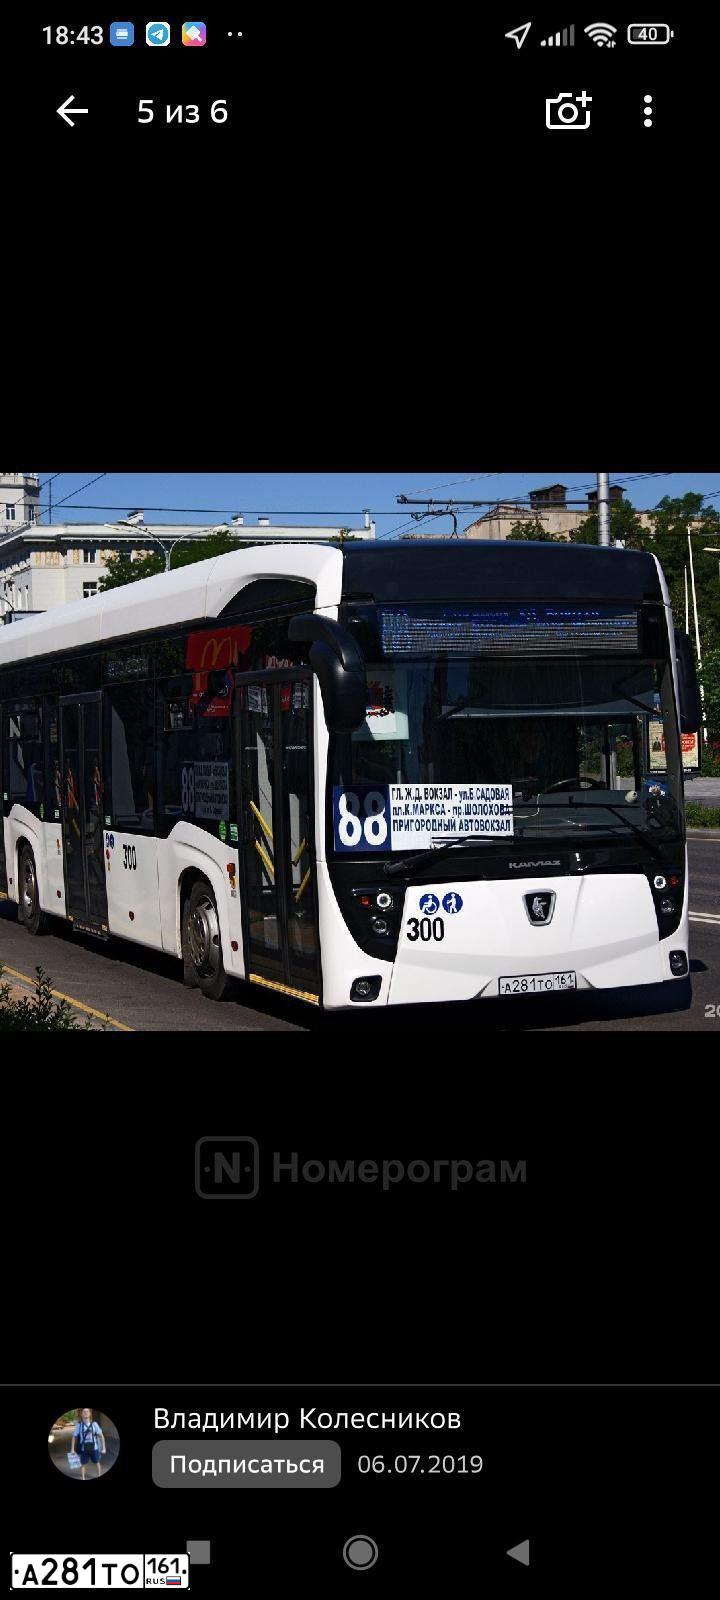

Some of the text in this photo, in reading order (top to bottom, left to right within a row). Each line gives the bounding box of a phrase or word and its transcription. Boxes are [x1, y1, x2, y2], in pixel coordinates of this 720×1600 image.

[392, 788, 404, 801] ГЛ.
[405, 788, 422, 802] Ж.Д.
[424, 788, 453, 801] ВОКЗАЛ
[338, 791, 388, 847] 88
[392, 816, 511, 832] ПРИГОРОДНЫЙ АВТОВОКЗАЛ
[122, 844, 137, 871] 300
[406, 916, 445, 942] 300
[555, 973, 574, 985] 161
